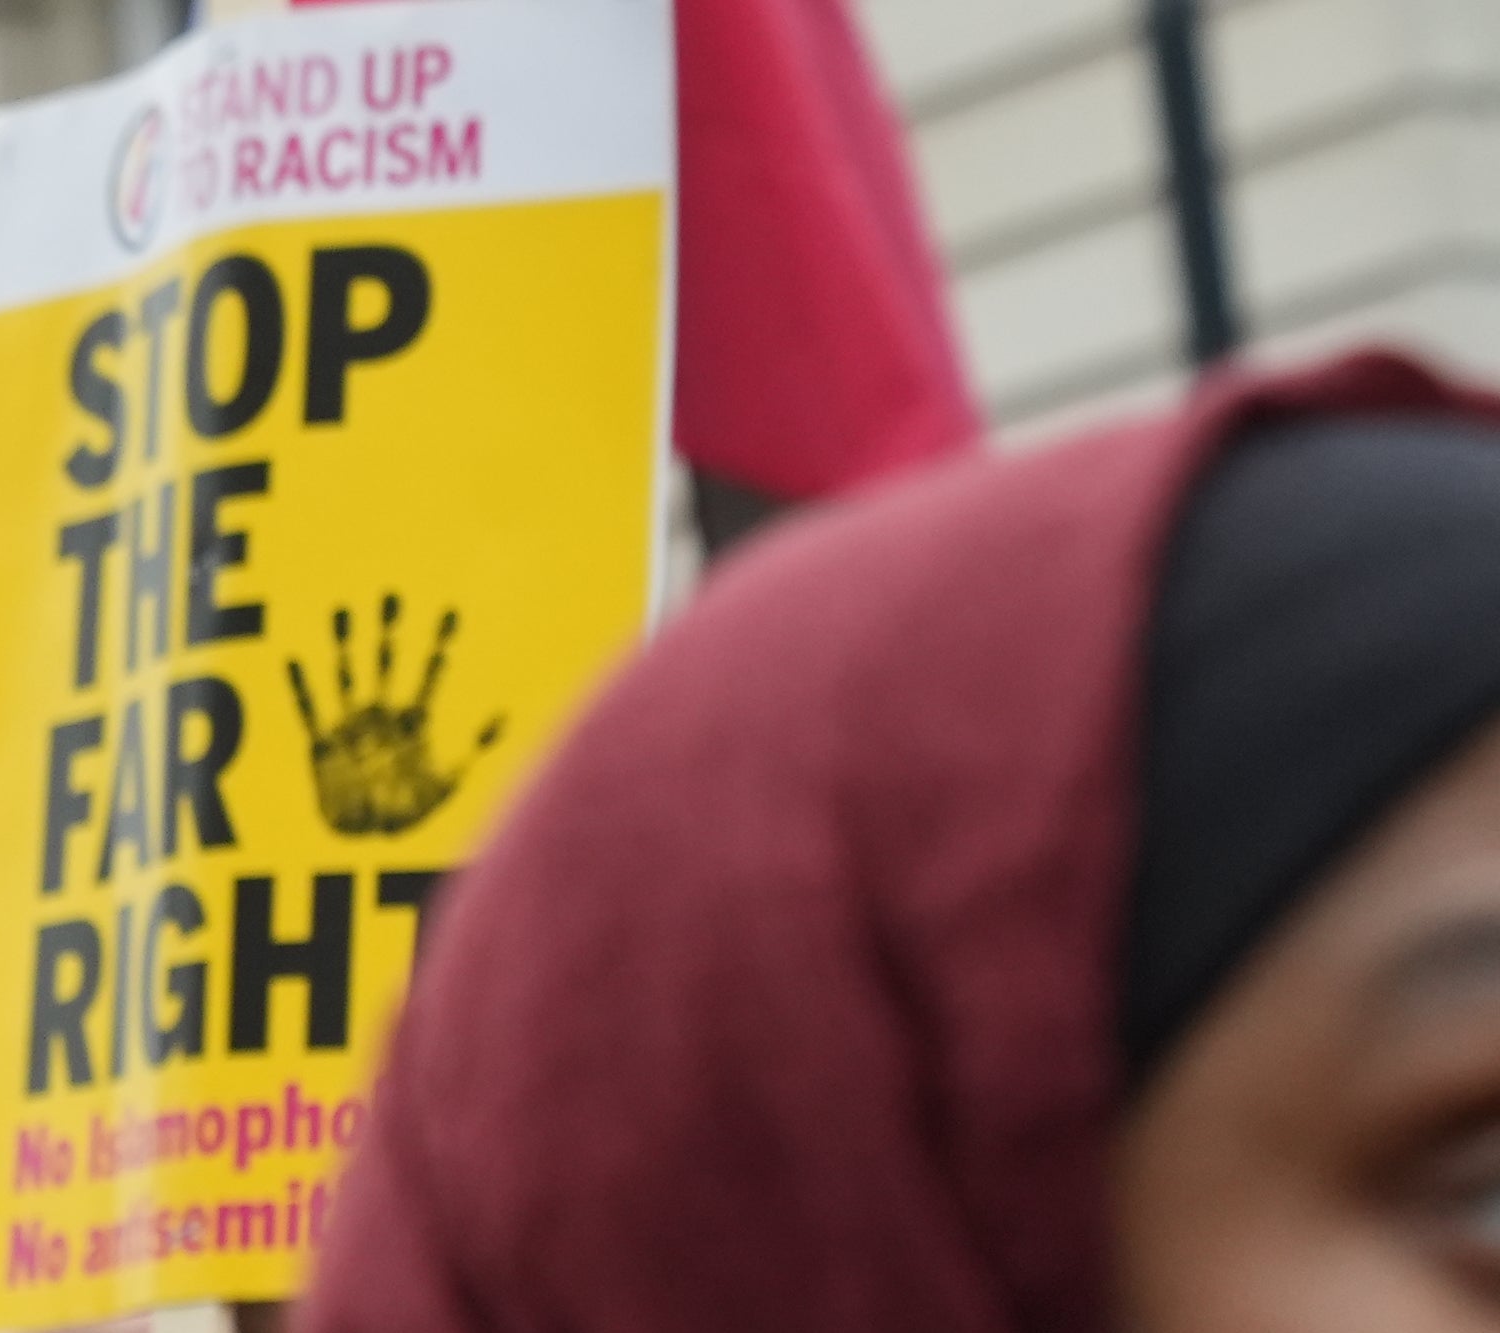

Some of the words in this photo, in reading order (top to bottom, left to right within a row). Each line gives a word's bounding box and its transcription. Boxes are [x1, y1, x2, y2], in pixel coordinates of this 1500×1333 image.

[362, 45, 454, 112] UP
[231, 117, 484, 198] RACISM
[62, 242, 434, 489] STOP
[56, 459, 273, 694] THE
[38, 675, 245, 896] FAR
[13, 1125, 75, 1193] No
[5, 1218, 70, 1290] No
